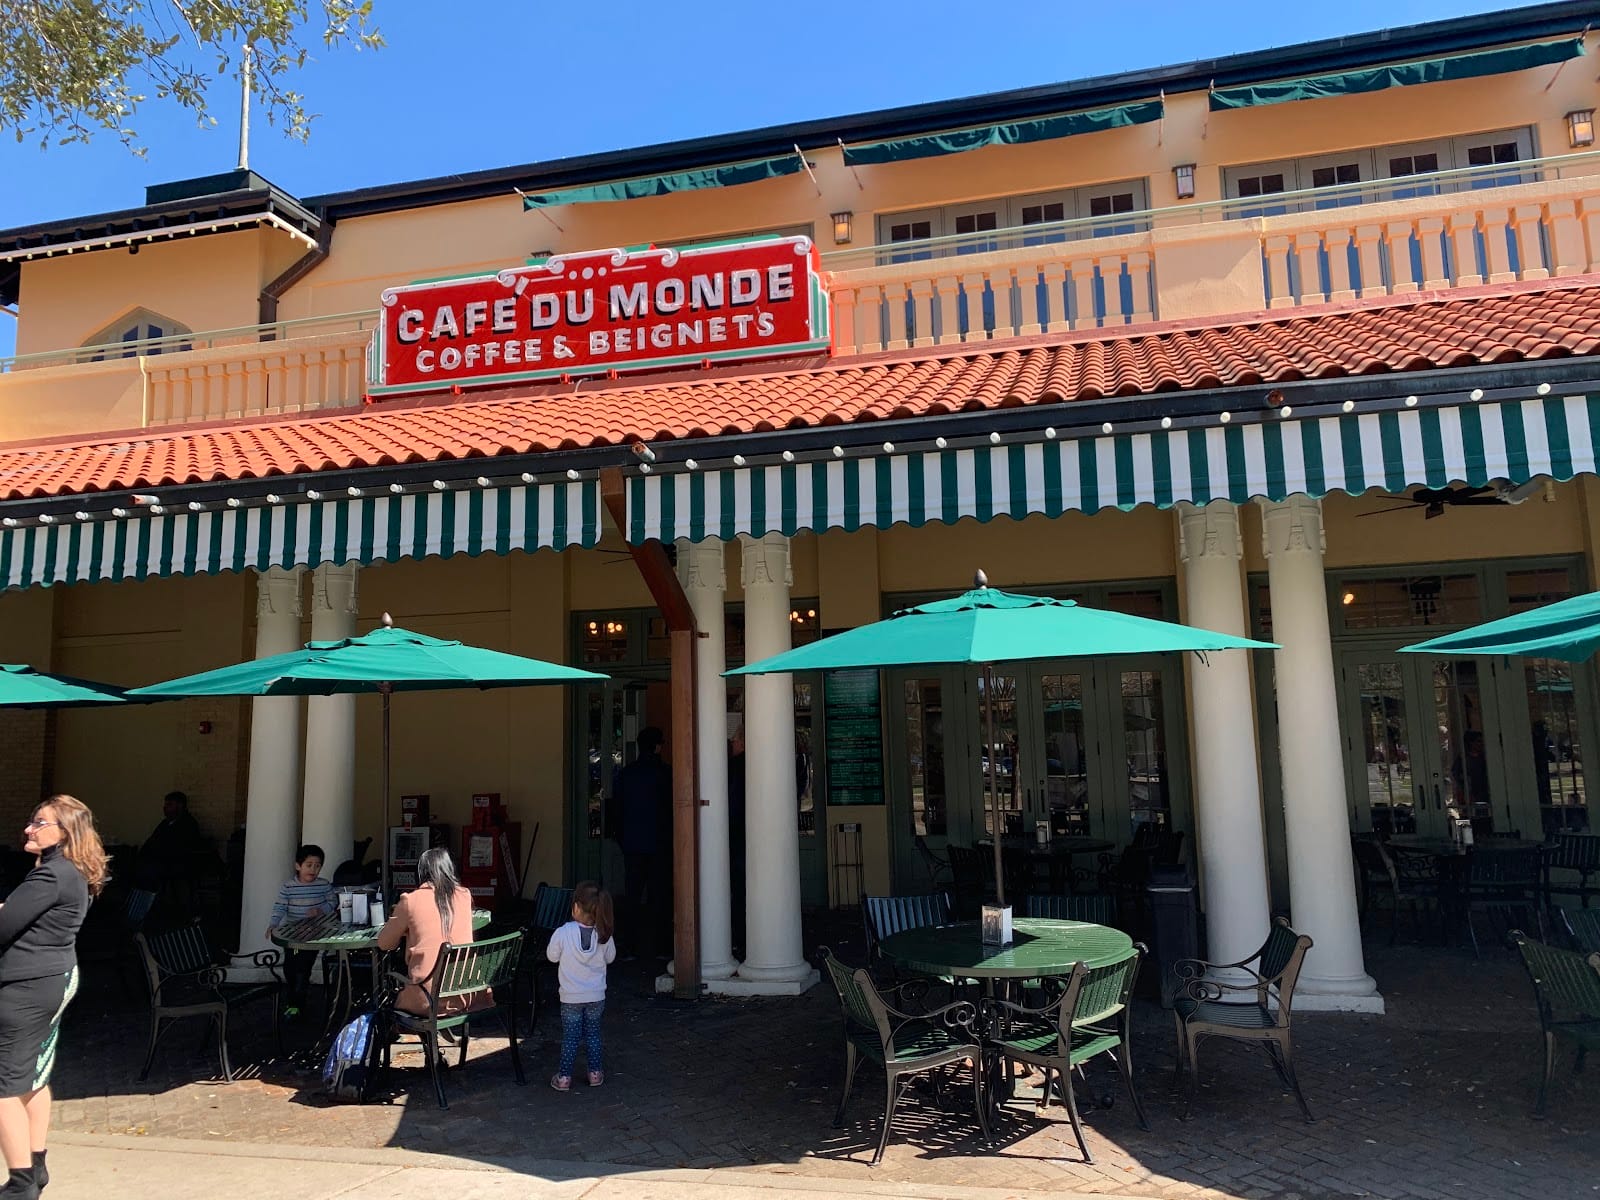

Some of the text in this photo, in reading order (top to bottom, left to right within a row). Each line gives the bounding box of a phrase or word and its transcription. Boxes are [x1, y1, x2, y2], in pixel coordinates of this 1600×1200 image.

[532, 288, 594, 328] DU
[609, 264, 794, 320] MONDE
[416, 312, 775, 373] COFFEE & BEIGNETS
